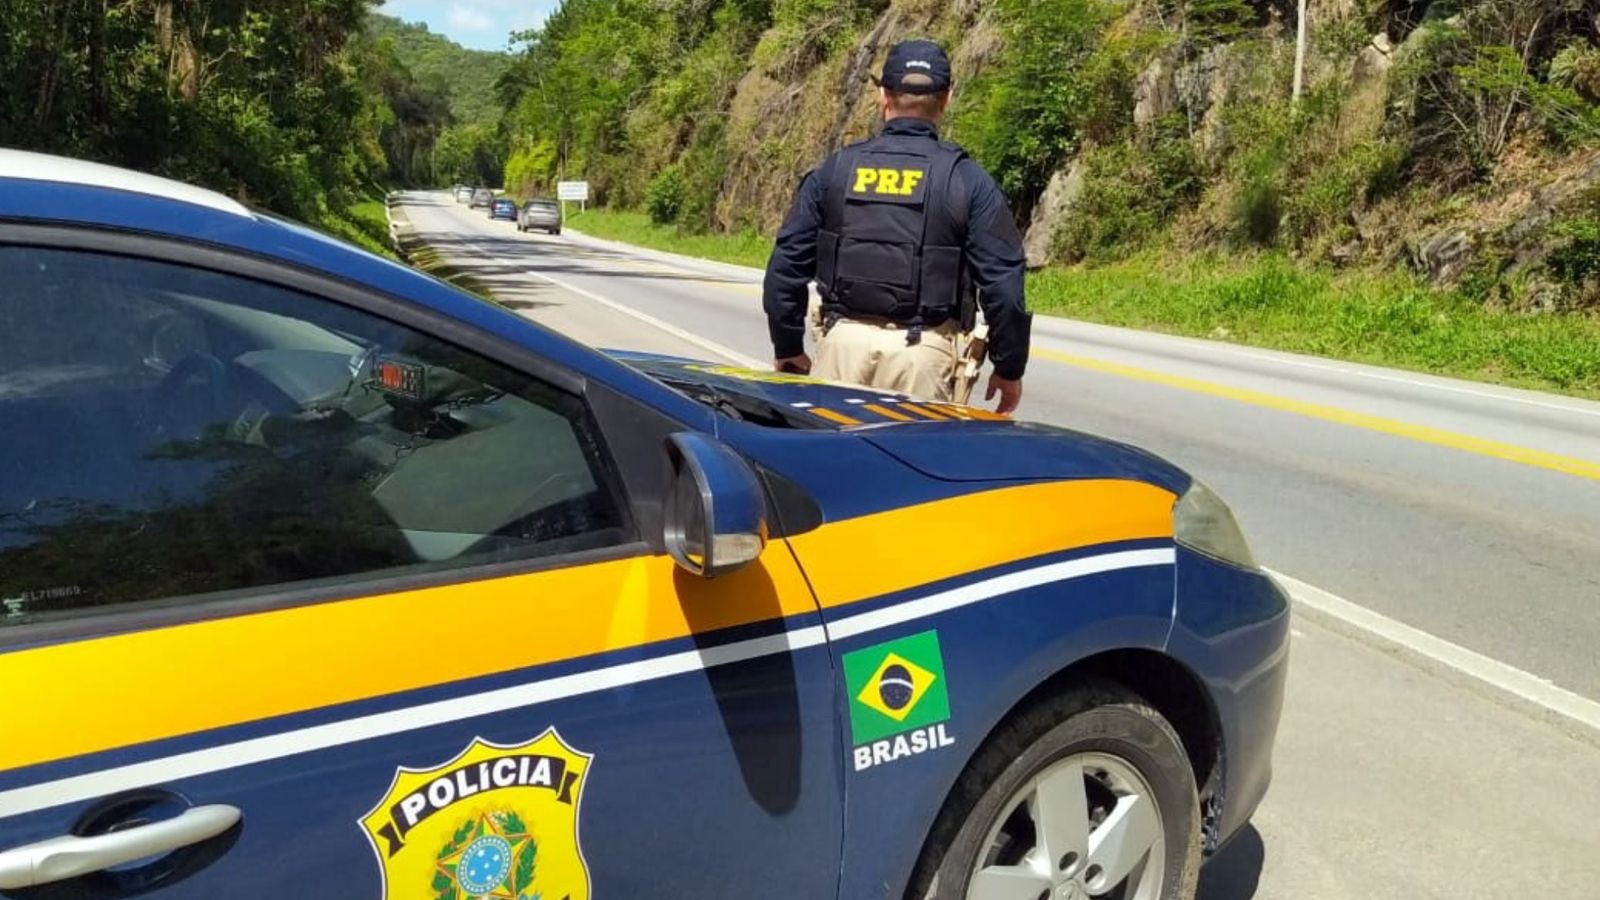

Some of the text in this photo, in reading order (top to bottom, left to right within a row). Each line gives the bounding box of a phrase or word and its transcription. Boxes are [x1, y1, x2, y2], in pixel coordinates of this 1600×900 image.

[853, 168, 923, 195] PRF
[853, 723, 956, 772] BRASIL
[399, 756, 552, 826] POLÍCIA
